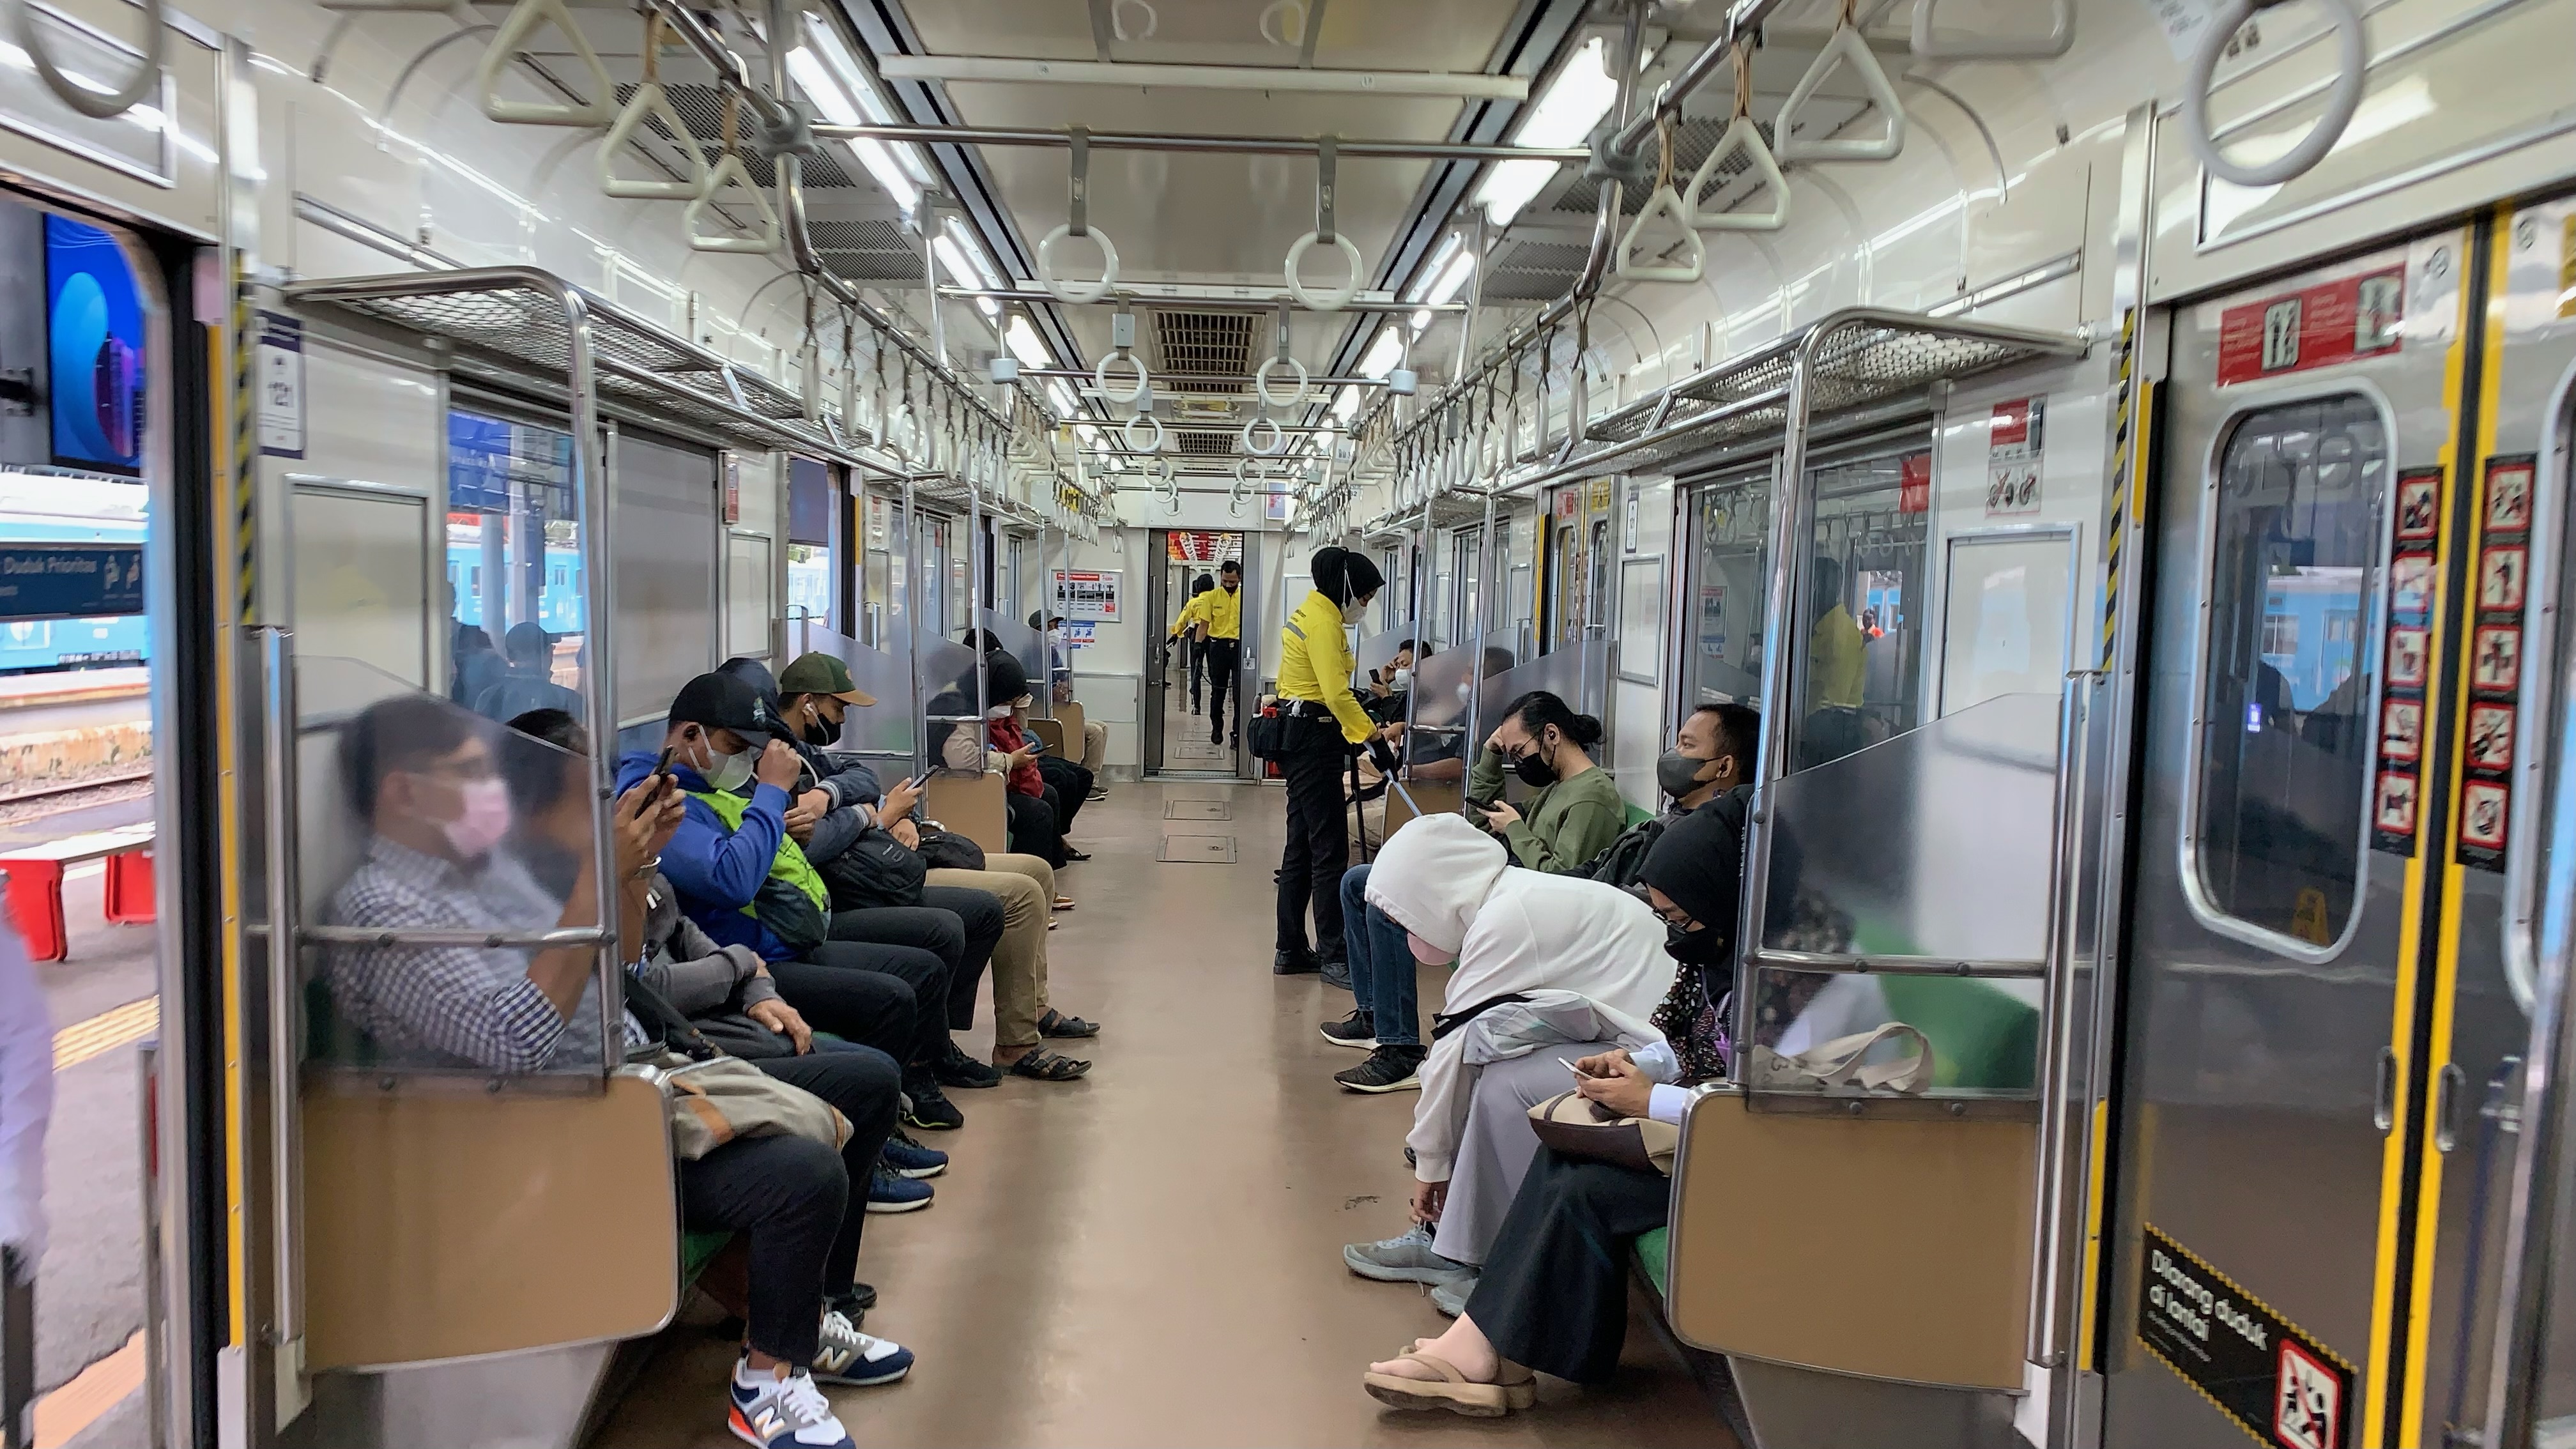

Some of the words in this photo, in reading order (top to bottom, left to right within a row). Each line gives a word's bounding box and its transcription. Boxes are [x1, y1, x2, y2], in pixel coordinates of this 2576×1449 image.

[2149, 1284, 2166, 1308] di
[2166, 1292, 2210, 1342] lantai
[2152, 1249, 2214, 1315] Dilarang
[2214, 1299, 2268, 1351] duduk
